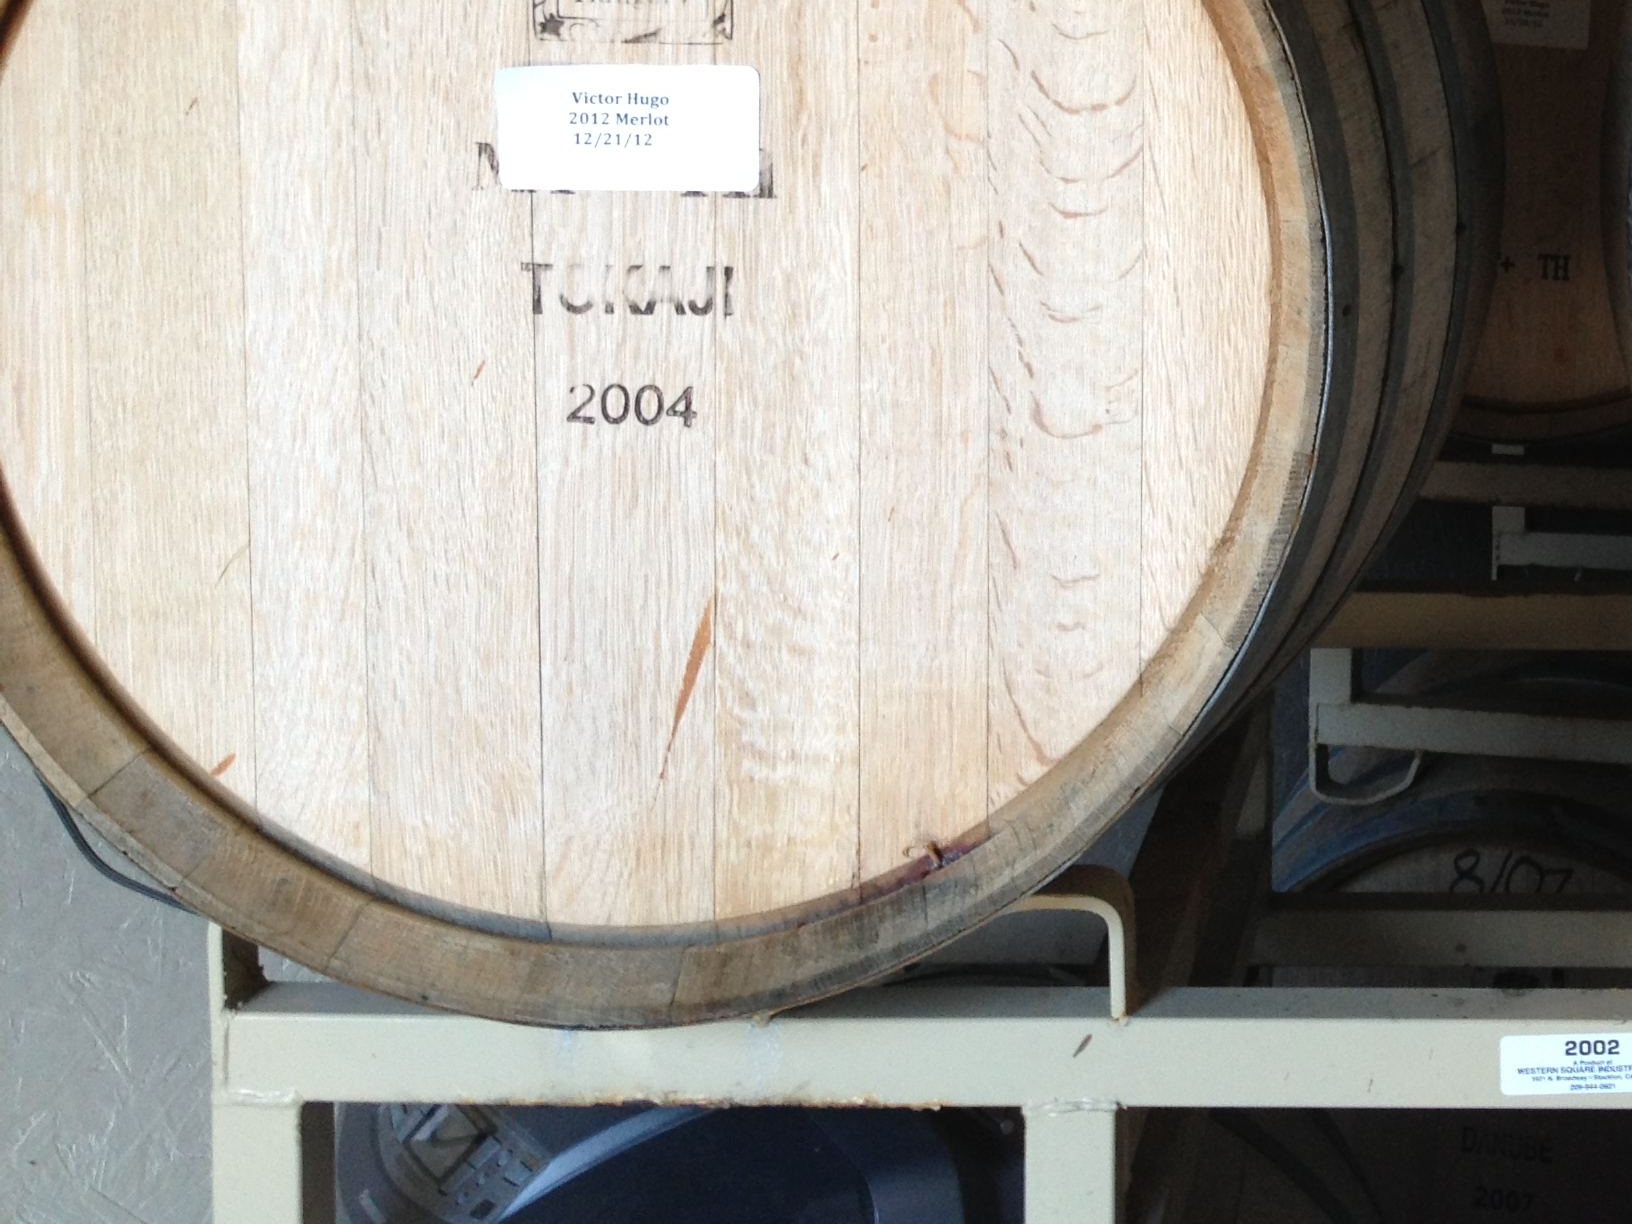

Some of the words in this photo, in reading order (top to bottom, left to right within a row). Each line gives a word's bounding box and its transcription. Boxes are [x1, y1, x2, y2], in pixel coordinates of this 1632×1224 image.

[572, 92, 622, 105] Victor
[627, 92, 670, 108] Hugo
[569, 113, 610, 126] 2012
[616, 113, 669, 126] Merlot
[574, 133, 653, 148] 12/21/12
[1538, 253, 1571, 281] TH
[567, 382, 698, 428] 2004
[1565, 1039, 1620, 1056] 2002
[1517, 1067, 1558, 1075] WESTERN
[1560, 1066, 1595, 1074] SQUARE
[1473, 1185, 1536, 1213] 2007
